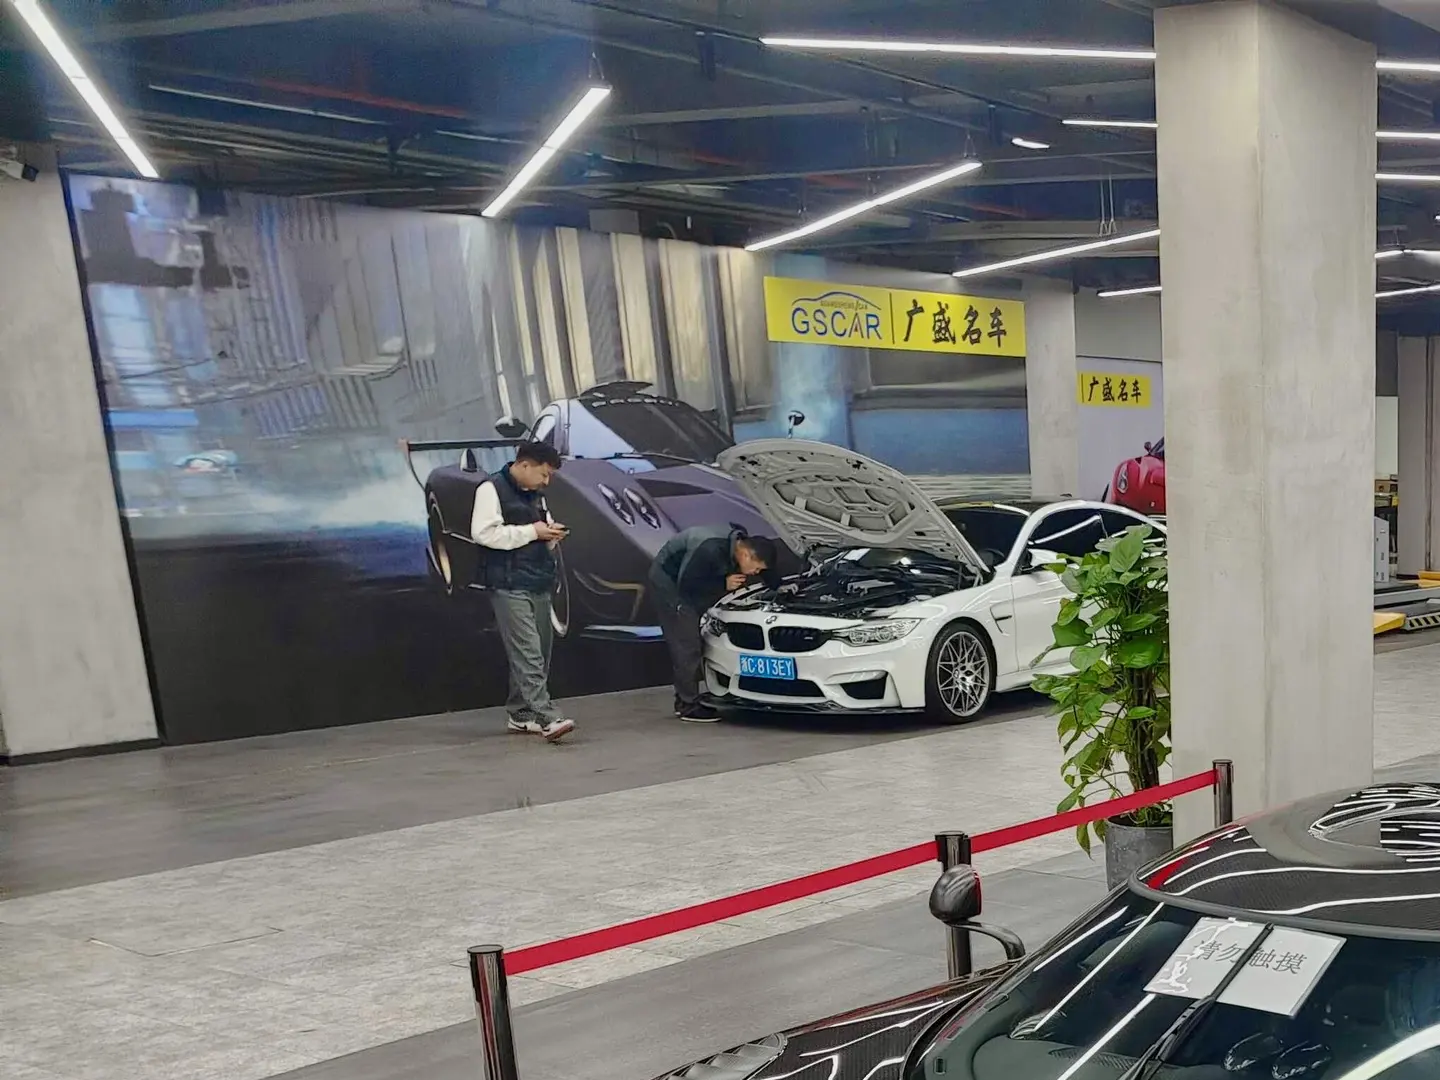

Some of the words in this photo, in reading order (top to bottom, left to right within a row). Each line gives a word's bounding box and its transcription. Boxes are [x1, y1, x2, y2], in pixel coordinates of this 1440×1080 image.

[791, 307, 882, 340] GSCAR
[904, 299, 1007, 348] 广盛名车
[1088, 376, 1141, 404] 广盛名车
